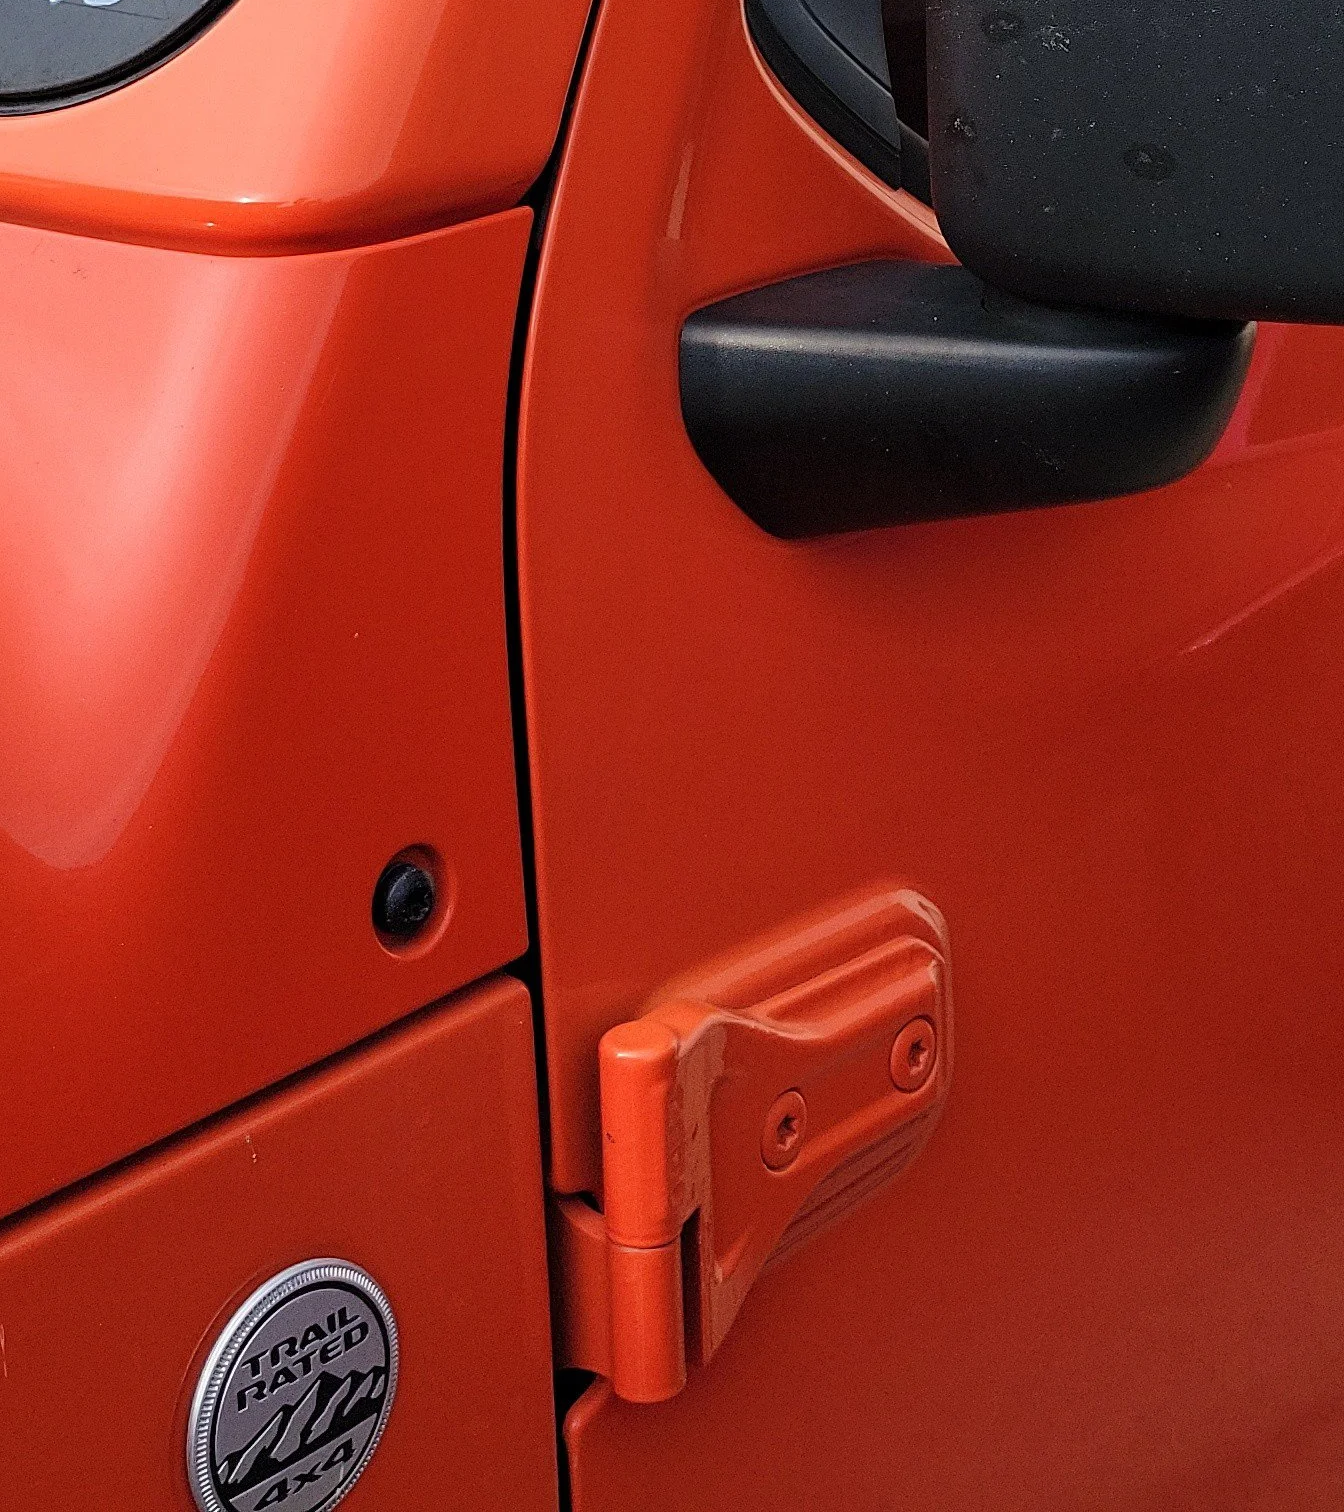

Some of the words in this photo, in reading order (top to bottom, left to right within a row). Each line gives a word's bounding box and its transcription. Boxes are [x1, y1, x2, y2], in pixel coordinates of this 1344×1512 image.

[236, 1320, 370, 1414] RATED
[241, 1306, 360, 1379] TRAIL
[253, 1436, 357, 1512] 4x4
